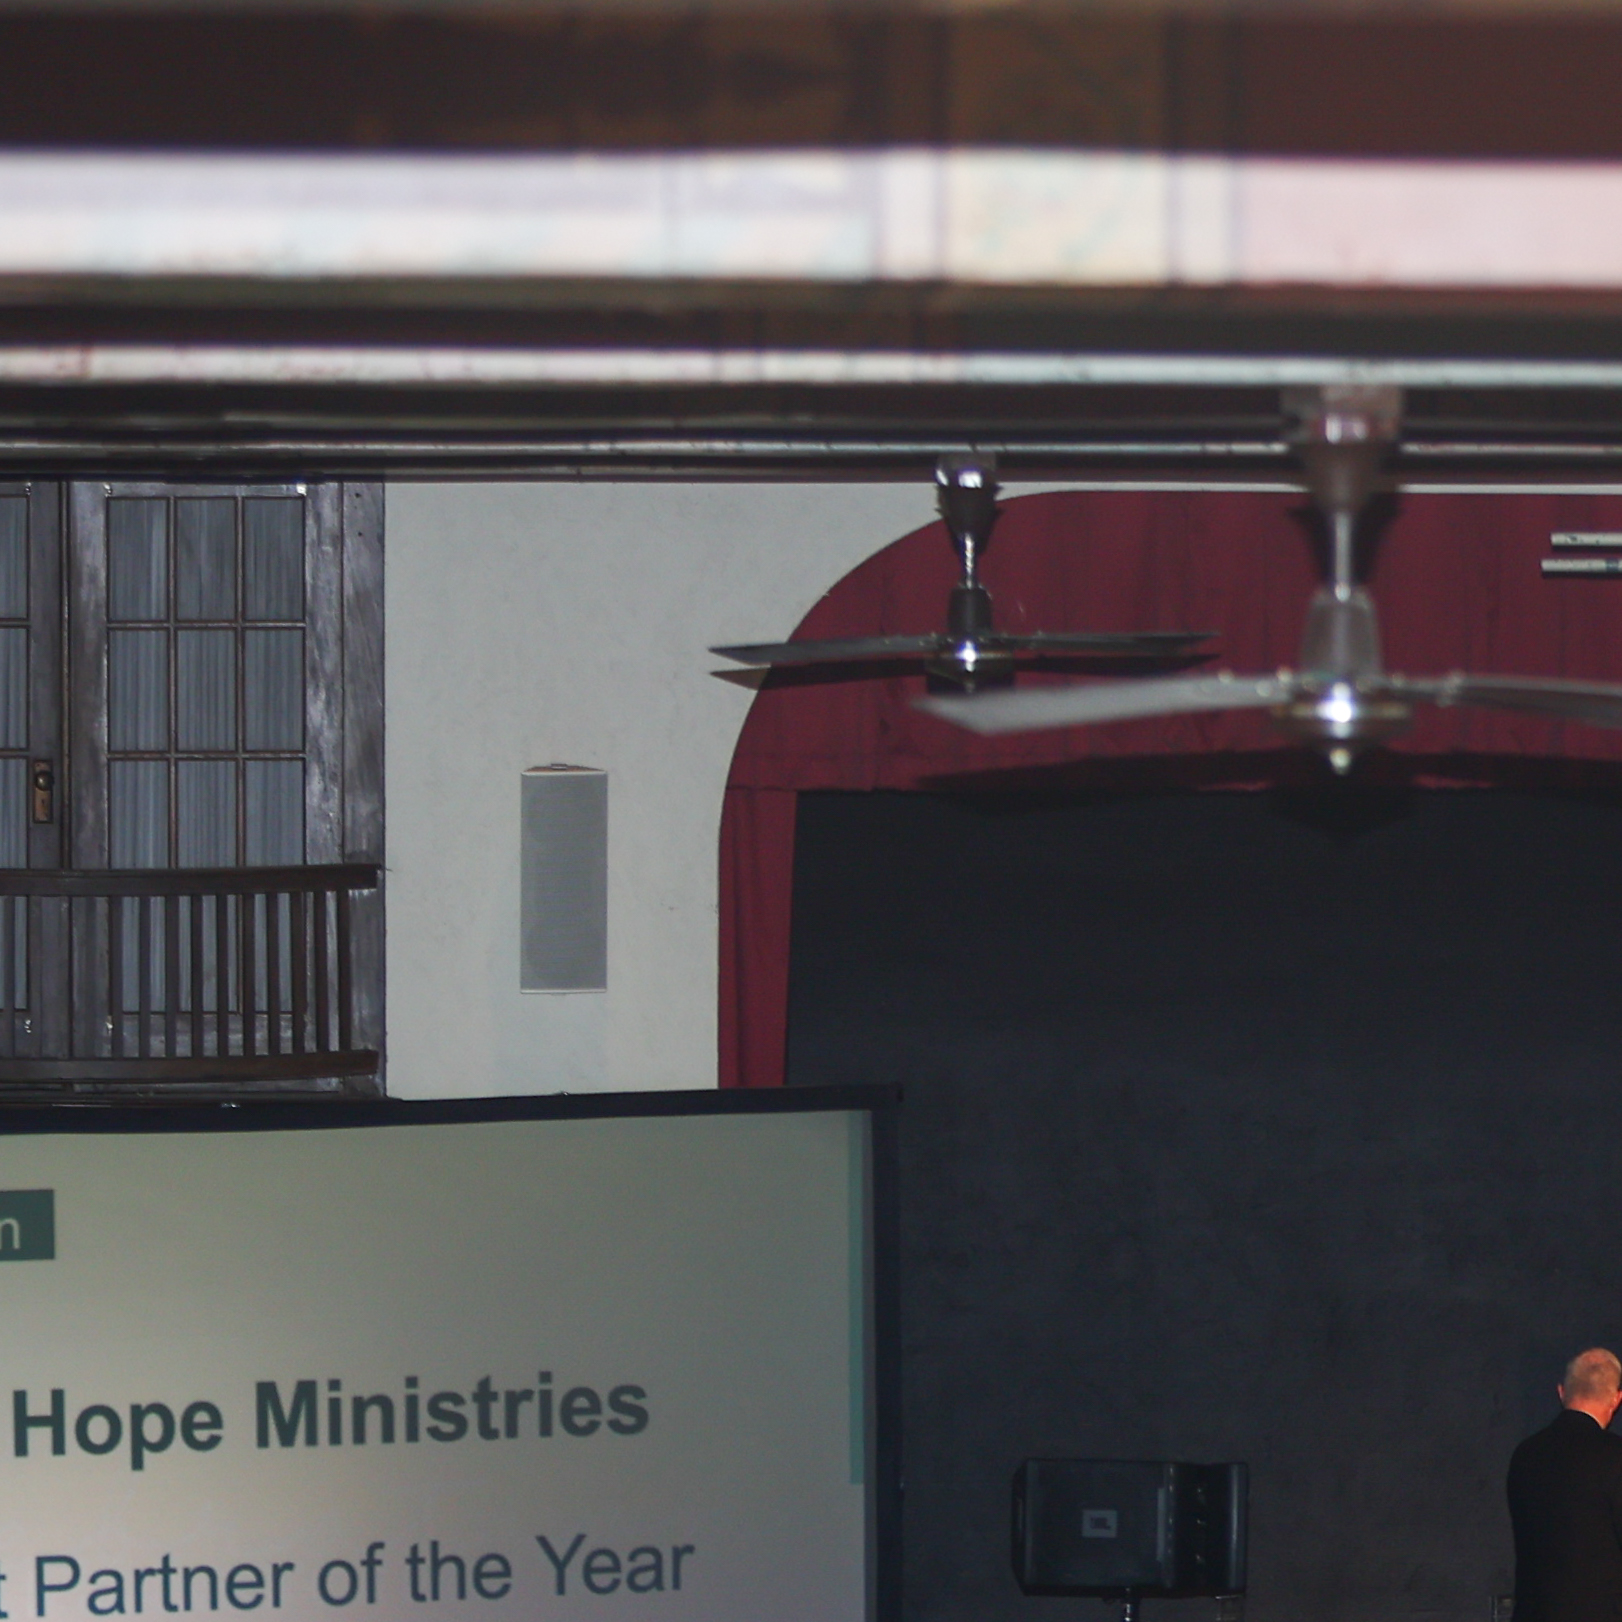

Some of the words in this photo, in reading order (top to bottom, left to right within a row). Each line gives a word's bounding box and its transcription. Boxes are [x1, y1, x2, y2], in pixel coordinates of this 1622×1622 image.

[12, 1388, 224, 1470] Hope
[254, 1371, 649, 1450] Ministries
[35, 1552, 294, 1620] Partner
[316, 1543, 385, 1608] of
[406, 1541, 512, 1603] the
[536, 1533, 696, 1598] Year
